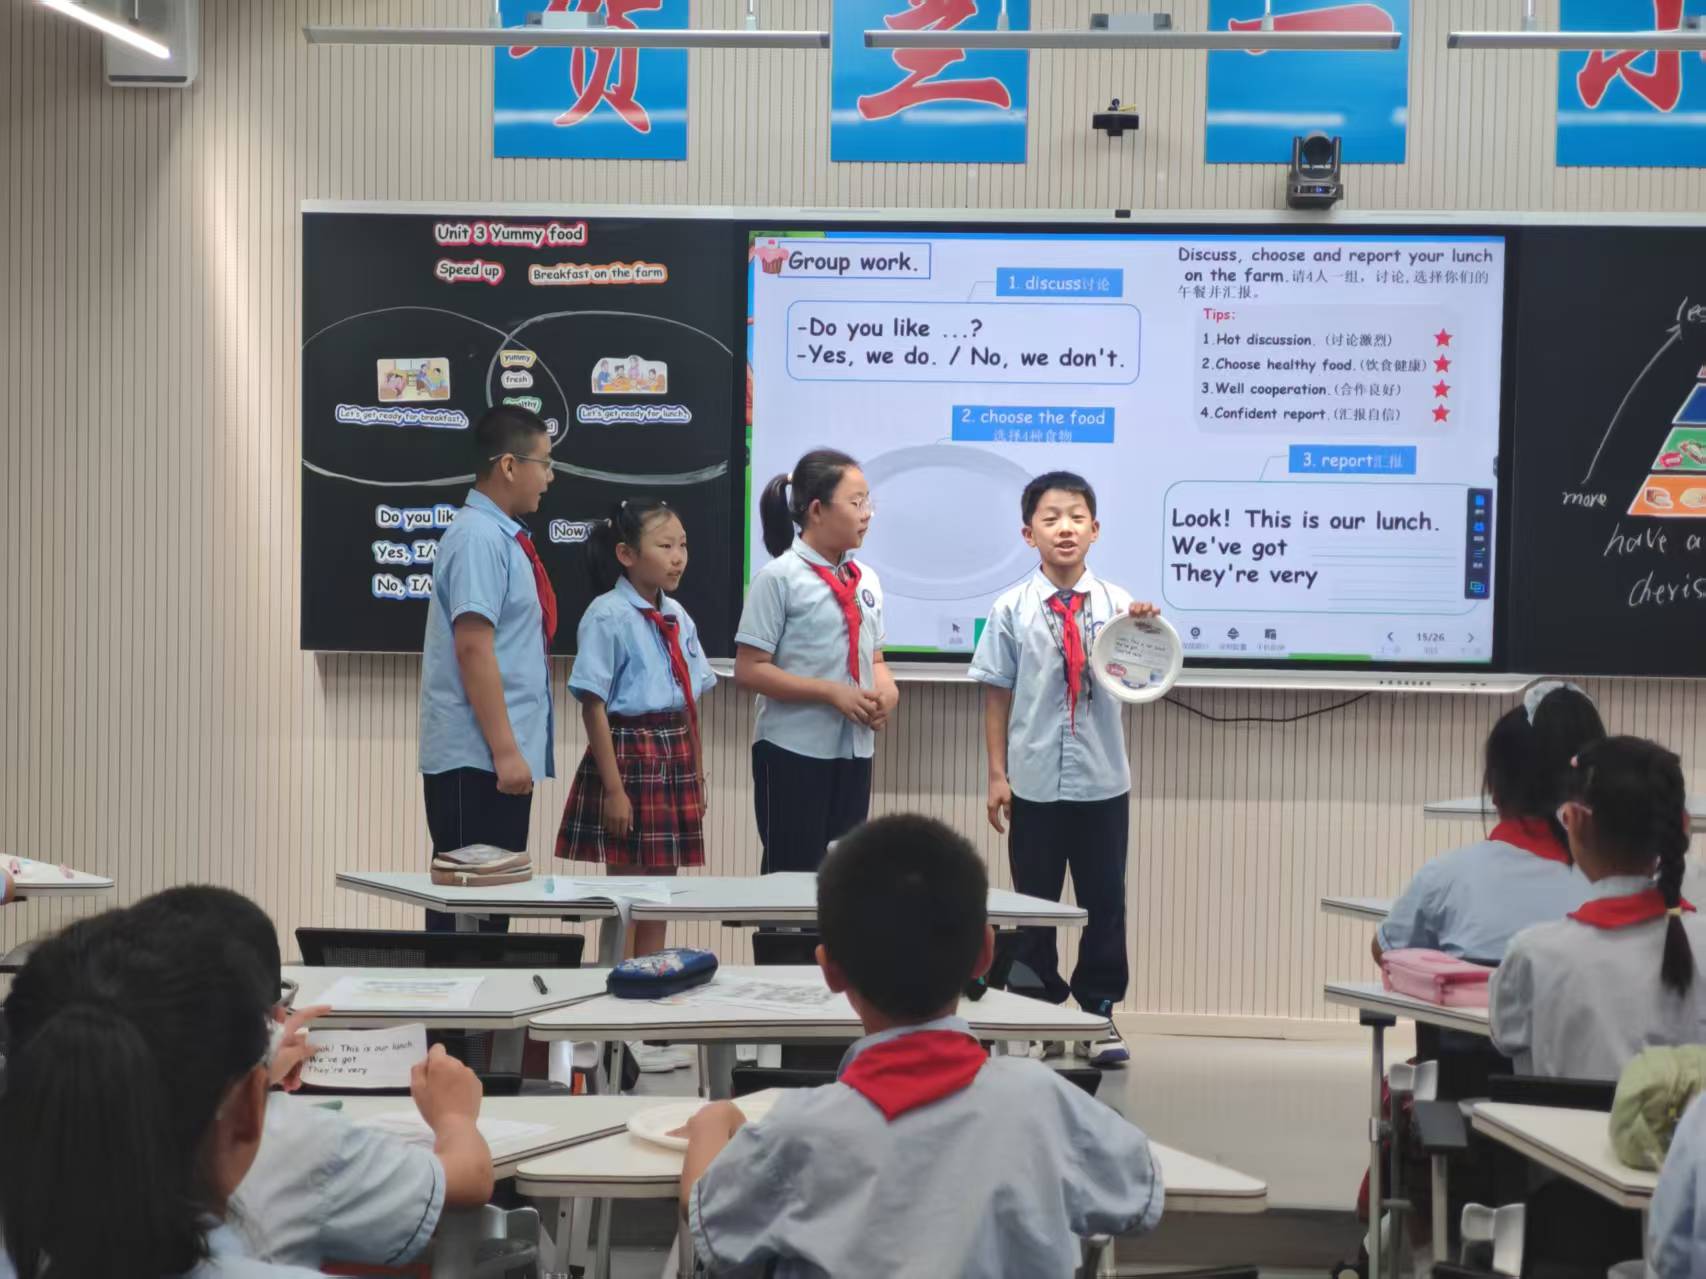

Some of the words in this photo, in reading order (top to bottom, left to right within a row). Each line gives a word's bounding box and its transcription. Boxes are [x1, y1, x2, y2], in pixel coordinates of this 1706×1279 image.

[437, 226, 469, 242] Unit
[475, 227, 486, 242] 3
[491, 226, 543, 247] Yummy
[548, 225, 584, 242] food
[788, 251, 850, 274] Group
[860, 252, 919, 272] work.
[1178, 247, 1243, 263] Discuss,
[1252, 247, 1306, 261] choose
[1313, 248, 1341, 262] and
[1349, 250, 1401, 265] report
[1408, 251, 1444, 266] your
[1452, 248, 1493, 262] lunch
[440, 262, 479, 279] Speed
[484, 266, 501, 279] up
[534, 266, 590, 281] Breakfast
[594, 270, 608, 280] on
[611, 267, 630, 280] the
[635, 266, 664, 280] farm
[1184, 271, 1203, 282] on
[1210, 268, 1237, 282] the
[1203, 308, 1236, 324] Tips:
[847, 320, 883, 341] you
[894, 318, 931, 337] like
[866, 348, 894, 365] we
[905, 346, 937, 365] do.
[949, 347, 960, 365] /
[971, 347, 1008, 369] No,
[1021, 351, 1049, 367] we
[1060, 347, 1125, 368] don't.
[1267, 358, 1316, 374] healthy
[506, 375, 528, 384] fresh
[379, 411, 403, 422] ready
[405, 412, 418, 420] for
[621, 409, 646, 419] ready
[647, 409, 660, 417] for
[981, 409, 1032, 424] choose
[1039, 409, 1064, 424] the
[1071, 409, 1105, 425] food
[1562, 491, 1608, 507] more
[381, 510, 400, 523] Do
[406, 513, 431, 526] you
[1172, 508, 1230, 528] Look!
[1245, 509, 1292, 529] This
[1302, 511, 1319, 529] is
[1330, 514, 1365, 530] our
[1376, 511, 1440, 531] lunch.
[555, 525, 584, 536] Now
[1603, 522, 1668, 556] have
[377, 546, 409, 560] Yes,
[1172, 536, 1242, 555] We've
[1252, 538, 1288, 560] got
[1171, 563, 1259, 588] They're
[1270, 569, 1318, 589] very
[378, 578, 403, 593] No,
[1417, 633, 1446, 642] 15/26
